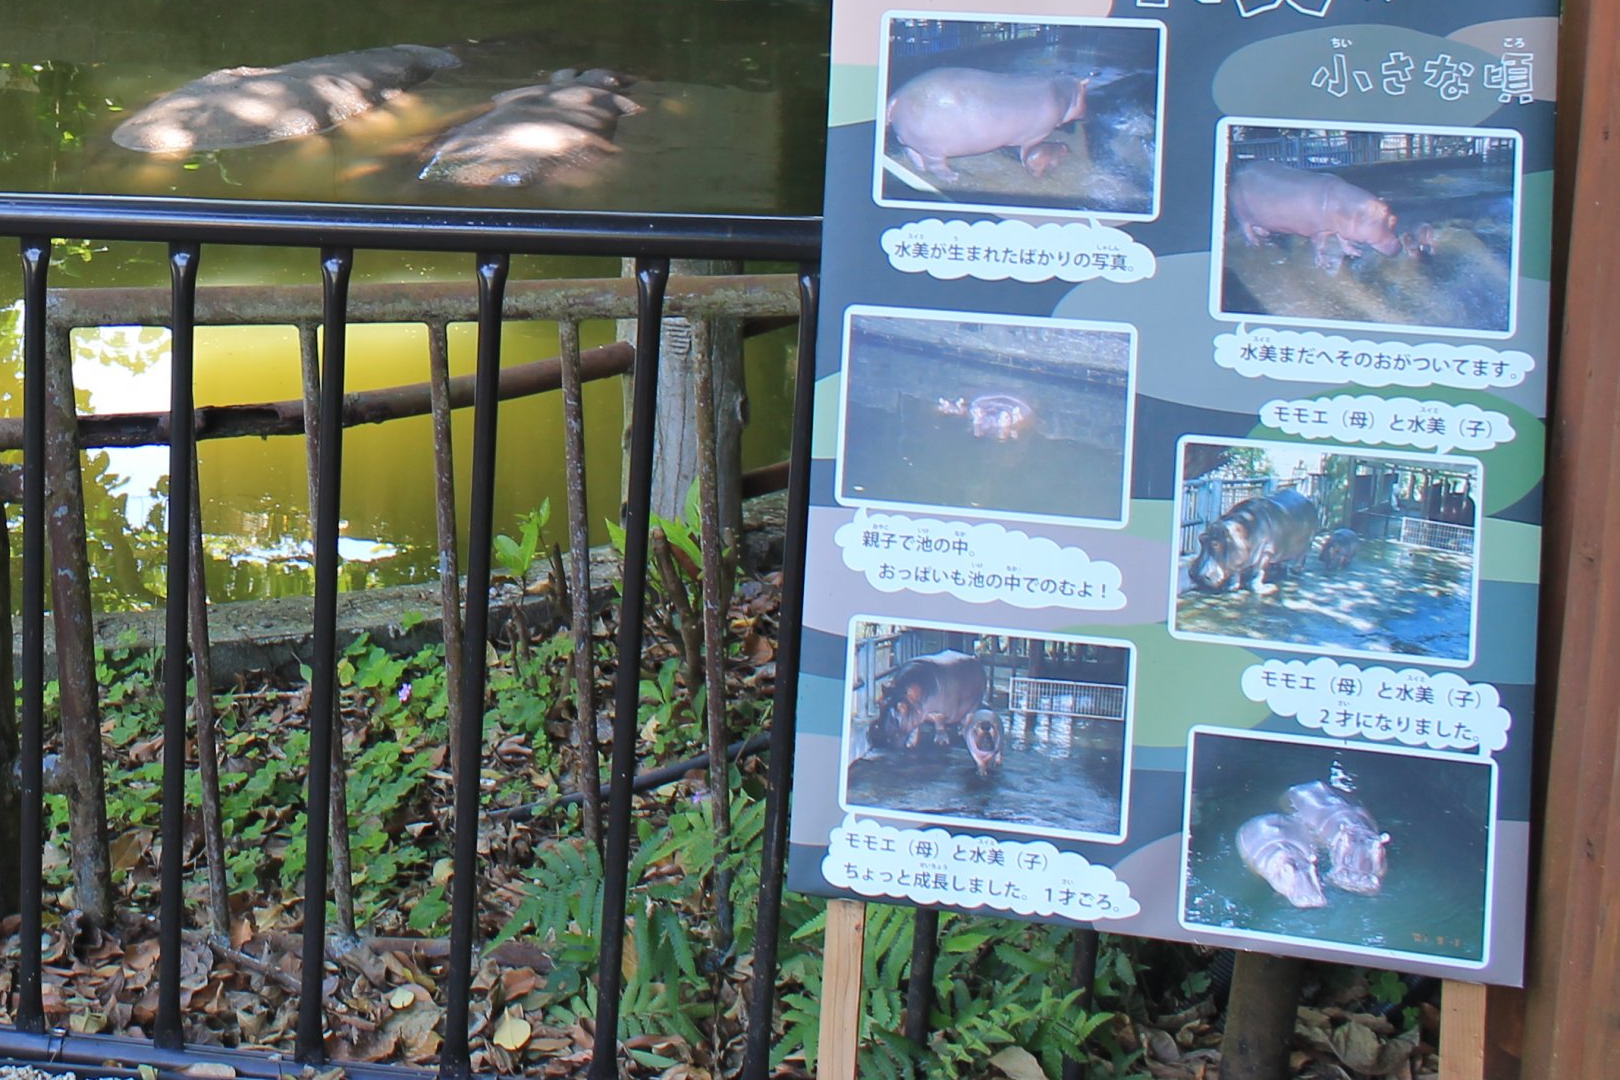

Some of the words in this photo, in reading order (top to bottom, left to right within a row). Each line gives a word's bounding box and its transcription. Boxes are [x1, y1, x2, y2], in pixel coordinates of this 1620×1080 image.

[1331, 37, 1352, 48] ちい
[1503, 37, 1525, 48] ころ
[1311, 52, 1534, 104] 小さな頃
[894, 241, 1134, 272] 水美が生まれたばかりの写真。
[1239, 343, 1517, 380] 水美まだへそのおがついてます。
[862, 531, 975, 557] 親子で池の中。
